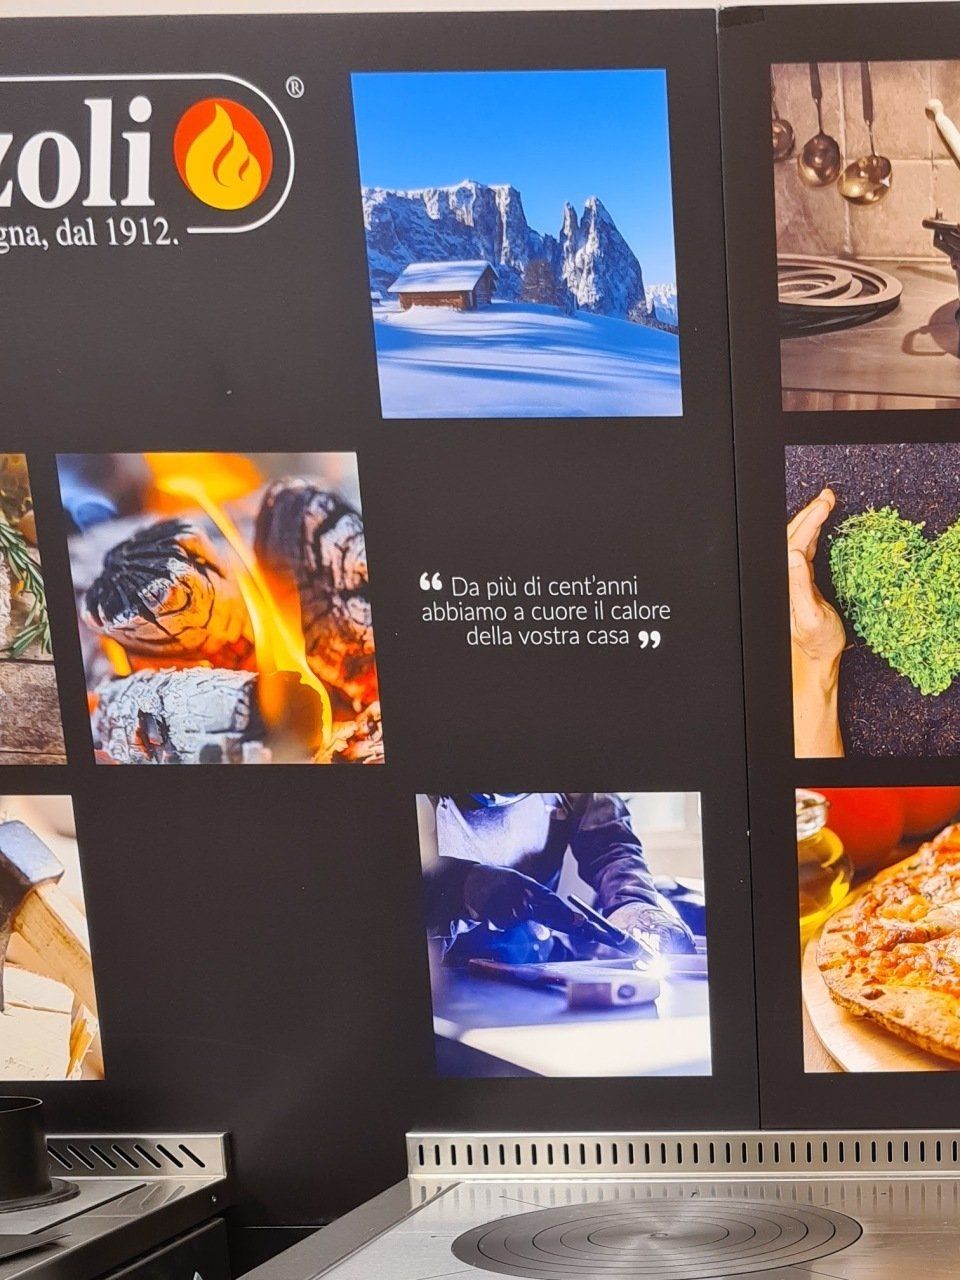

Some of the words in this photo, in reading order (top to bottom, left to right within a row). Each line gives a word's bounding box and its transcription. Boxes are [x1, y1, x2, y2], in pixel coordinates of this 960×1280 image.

[0, 95, 155, 209] oli
[56, 217, 97, 246] dal
[107, 217, 179, 246] 1912.
[452, 576, 480, 597] Da
[487, 576, 517, 601] più
[524, 575, 541, 597] di
[422, 600, 507, 621] abbiamo
[513, 606, 525, 621] a
[531, 606, 588, 621] cuore
[594, 600, 604, 620] il
[610, 600, 671, 620] calore
[466, 625, 513, 646] della
[518, 627, 580, 645] vostra
[586, 630, 630, 645] casa
